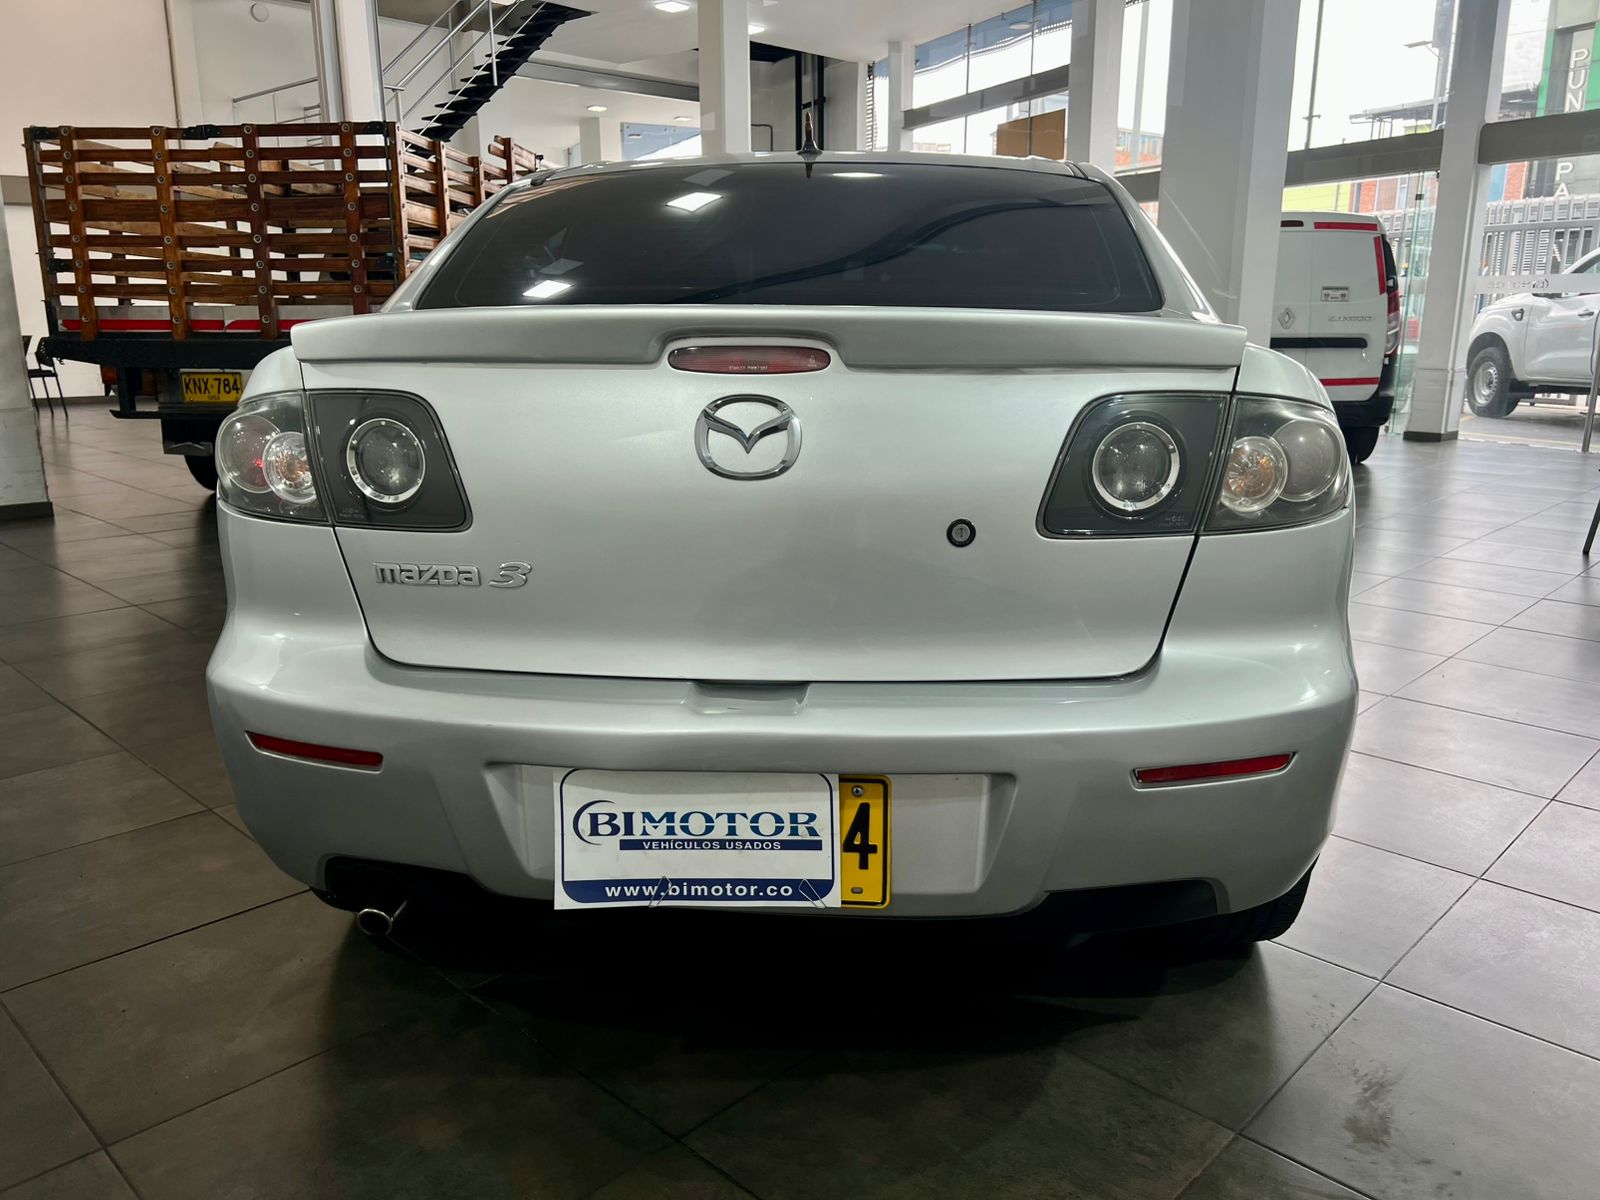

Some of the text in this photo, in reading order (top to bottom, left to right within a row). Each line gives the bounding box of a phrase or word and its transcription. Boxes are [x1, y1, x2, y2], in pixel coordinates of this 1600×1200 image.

[488, 561, 532, 588] 3
[587, 811, 821, 838] BIMOTOR
[842, 802, 878, 870] 4
[643, 840, 781, 850] VEHÍCULOS USADOS
[605, 882, 793, 897] www.bimotor.co
